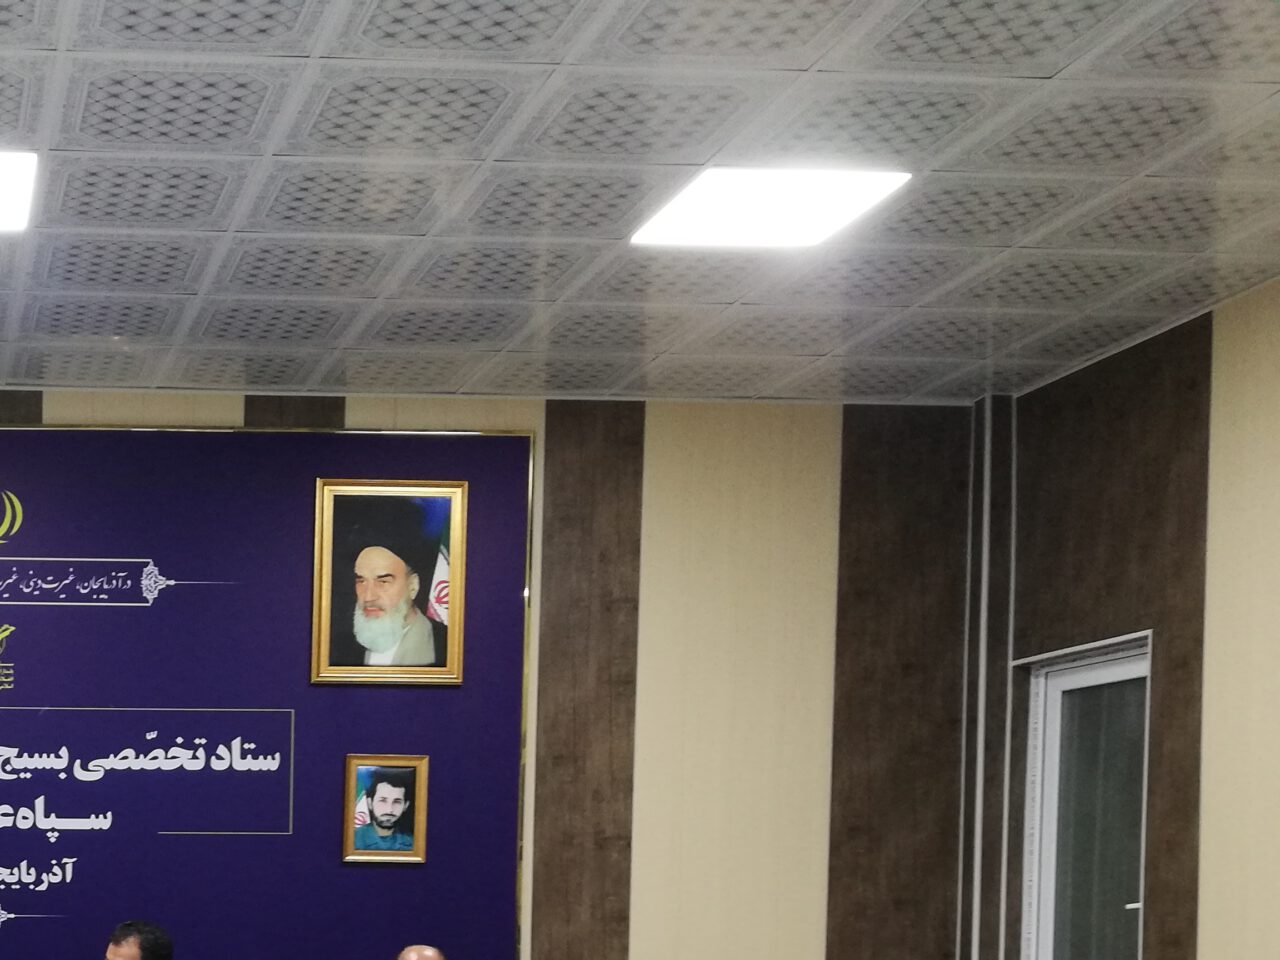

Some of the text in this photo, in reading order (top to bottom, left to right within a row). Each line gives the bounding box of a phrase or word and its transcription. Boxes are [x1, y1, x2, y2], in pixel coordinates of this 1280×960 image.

[41, 566, 77, 599] غیرت
[210, 736, 281, 771] ستاد
[15, 794, 113, 843] سپاه
